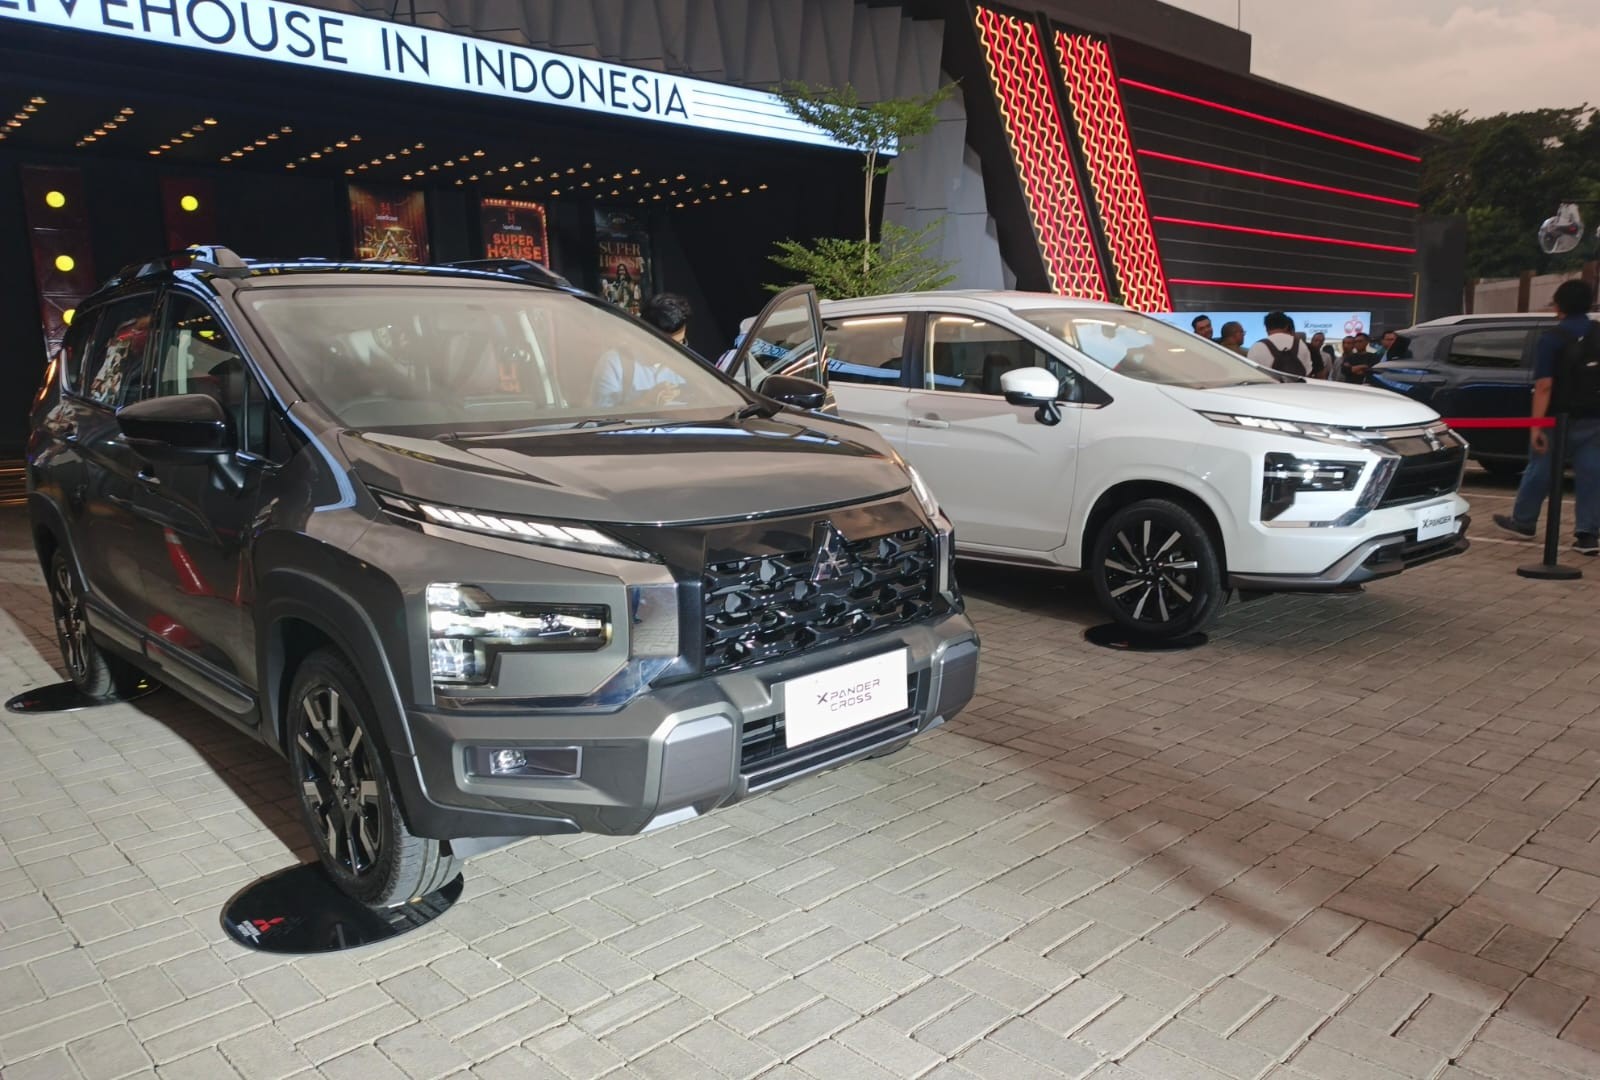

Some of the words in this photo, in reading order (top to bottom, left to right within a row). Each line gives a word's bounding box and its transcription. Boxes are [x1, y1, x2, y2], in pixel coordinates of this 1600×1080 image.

[0, 0, 348, 64] EHOUSE
[381, 27, 430, 77] IN
[462, 42, 689, 119] INDONESIA
[492, 232, 534, 247] SUPER
[599, 240, 641, 256] SUPER
[486, 243, 542, 260] HOUSE
[816, 678, 881, 705] XPANDER
[830, 691, 873, 712] CROSS
